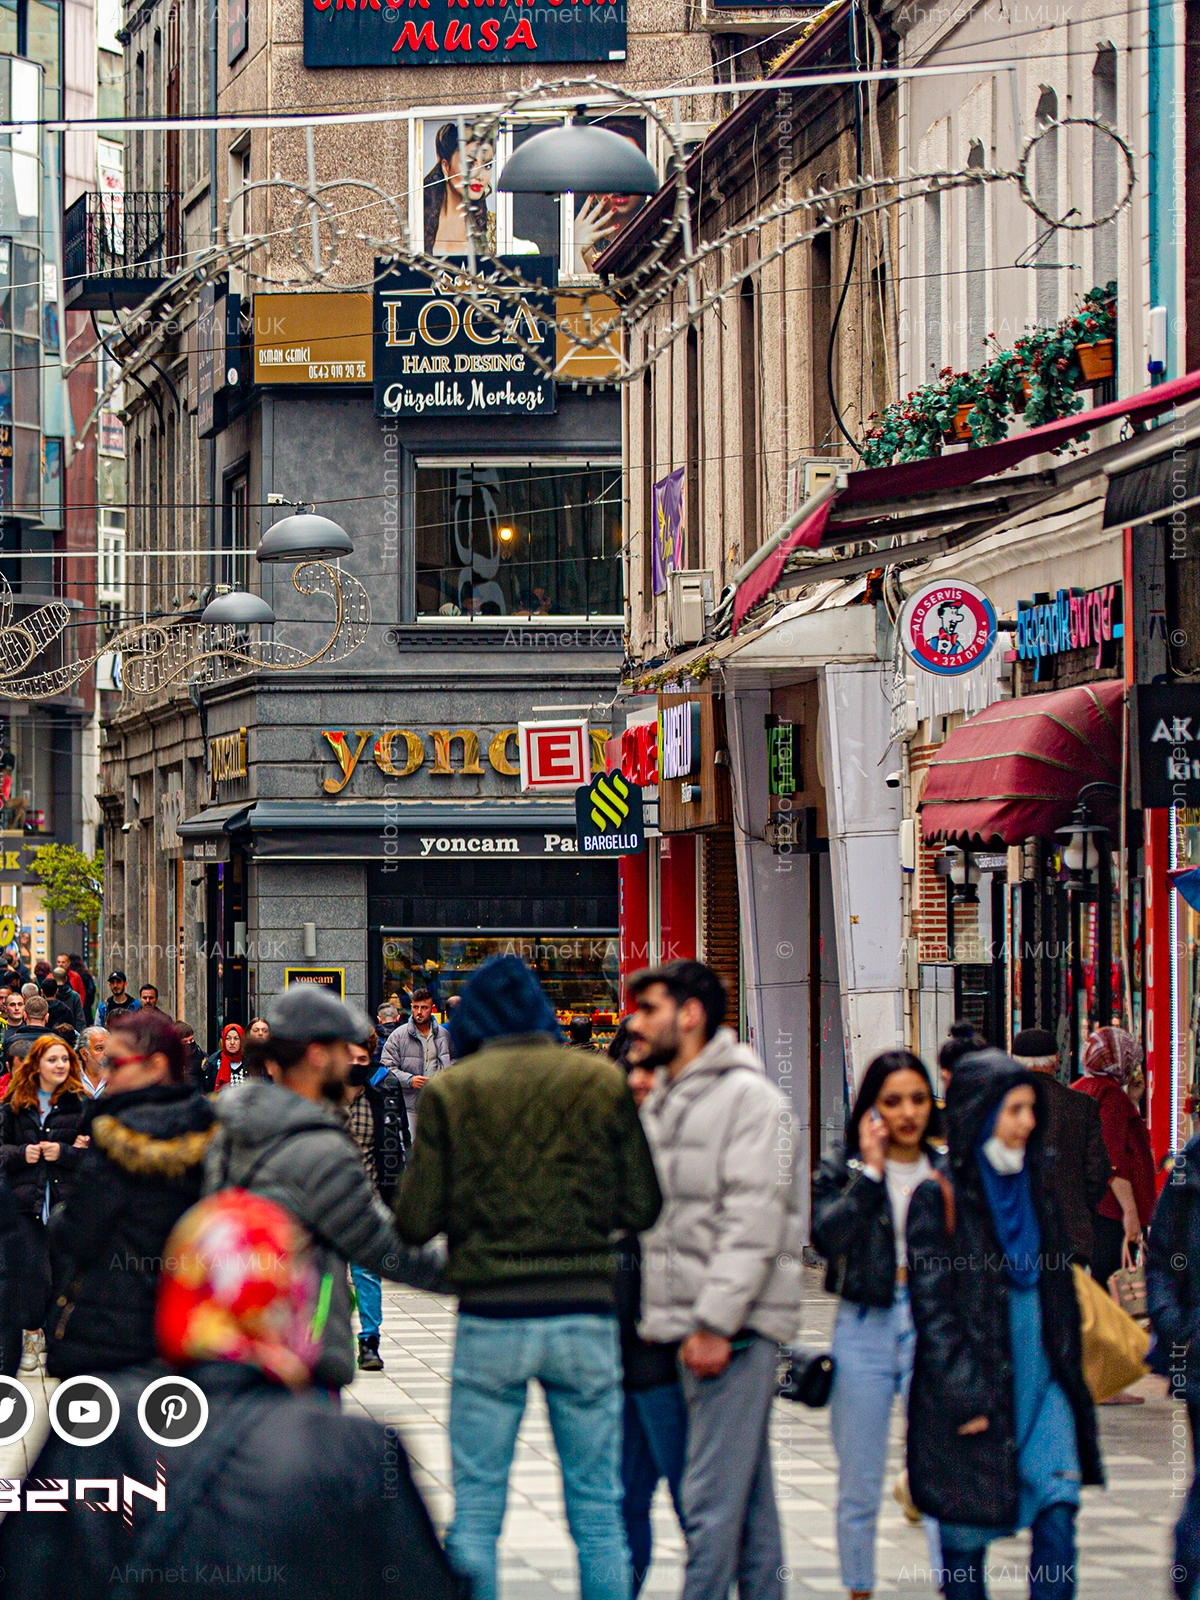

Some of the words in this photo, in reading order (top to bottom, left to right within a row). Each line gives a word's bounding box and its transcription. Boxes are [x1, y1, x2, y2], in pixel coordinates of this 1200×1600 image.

[392, 18, 538, 52] MUSA
[383, 298, 545, 346] LOCA
[259, 349, 283, 362] OSMAN
[285, 346, 310, 362] GEMİCİ
[402, 355, 451, 374] HAIR
[454, 354, 526, 372] DESING
[308, 365, 329, 379] 0543
[331, 365, 342, 379] 919
[345, 365, 354, 378] 29
[383, 381, 464, 412] Güzellik
[466, 379, 544, 411] Merkezi
[912, 610, 926, 631] ALO
[924, 588, 962, 608] SERVİS
[942, 655, 963, 666] 321
[966, 646, 979, 658] 07
[979, 630, 988, 646] 88
[538, 736, 574, 776] E
[420, 837, 520, 856] yoncam
[584, 834, 638, 850] BARGELLO
[295, 976, 334, 985] yoncam
